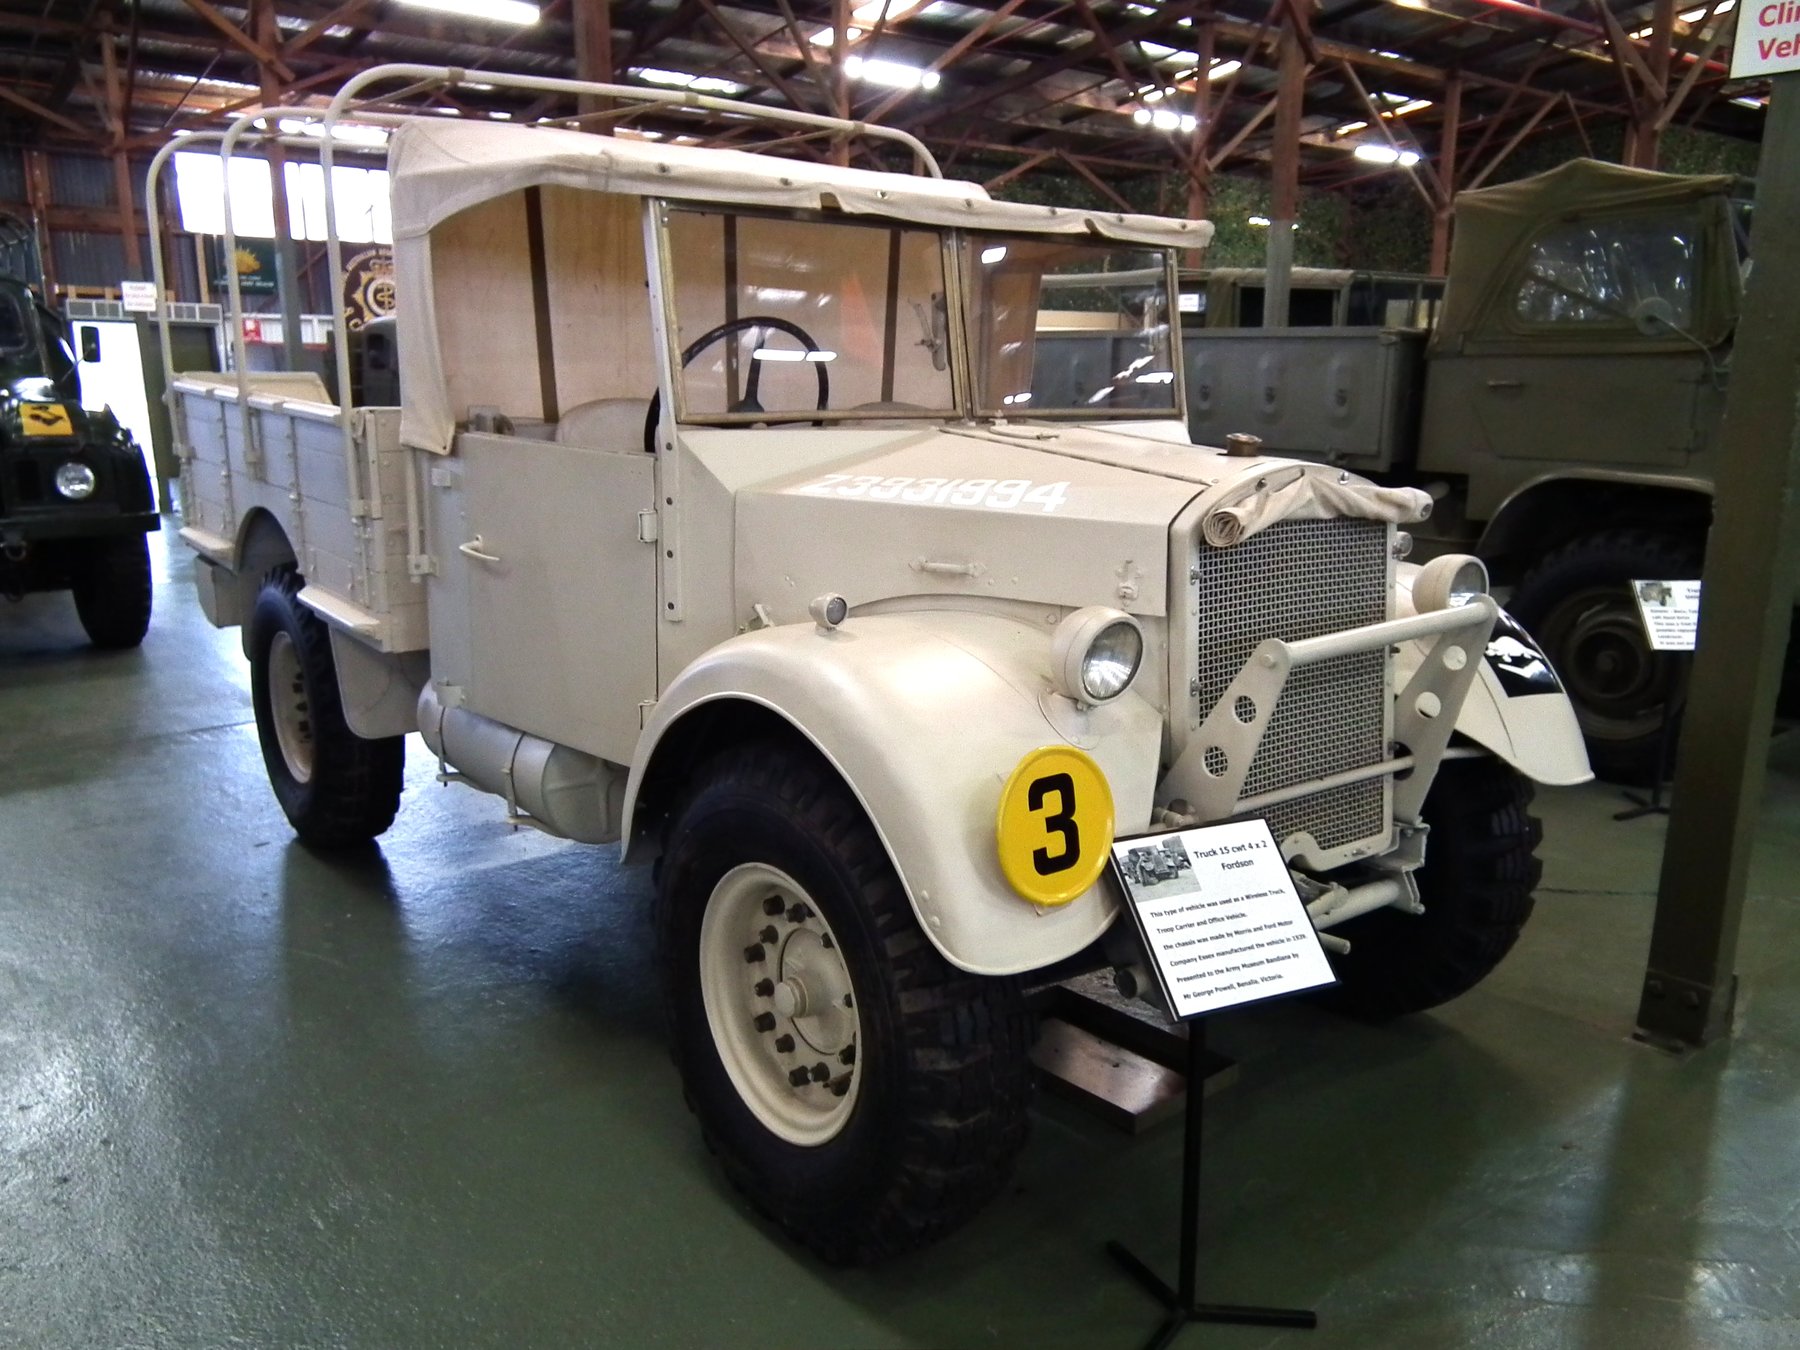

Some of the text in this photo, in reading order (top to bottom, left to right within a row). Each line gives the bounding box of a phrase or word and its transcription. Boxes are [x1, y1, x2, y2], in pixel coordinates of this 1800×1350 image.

[799, 474, 1070, 513] Z3931994
[1028, 773, 1080, 876] 3
[1193, 848, 1218, 859] Truck
[1219, 845, 1230, 855] 15
[1232, 843, 1247, 854] cwt
[1221, 859, 1254, 871] Fordson
[1150, 911, 1163, 919] This
[1164, 908, 1177, 917] type
[1185, 903, 1205, 912] vehicle
[1219, 897, 1232, 906] used
[1157, 926, 1174, 934] Troop
[1197, 919, 1207, 927] and
[1208, 916, 1225, 925] Office
[1175, 939, 1196, 949] chassis
[1210, 933, 1225, 941] made
[1253, 925, 1263, 933] and
[1264, 922, 1276, 930] Ford
[1170, 957, 1197, 967] Company
[1216, 943, 1255, 957] manufactured
[1266, 938, 1285, 947] vehicle
[1177, 971, 1206, 984] Presented
[1226, 965, 1240, 973] Army
[1193, 989, 1214, 998] George
